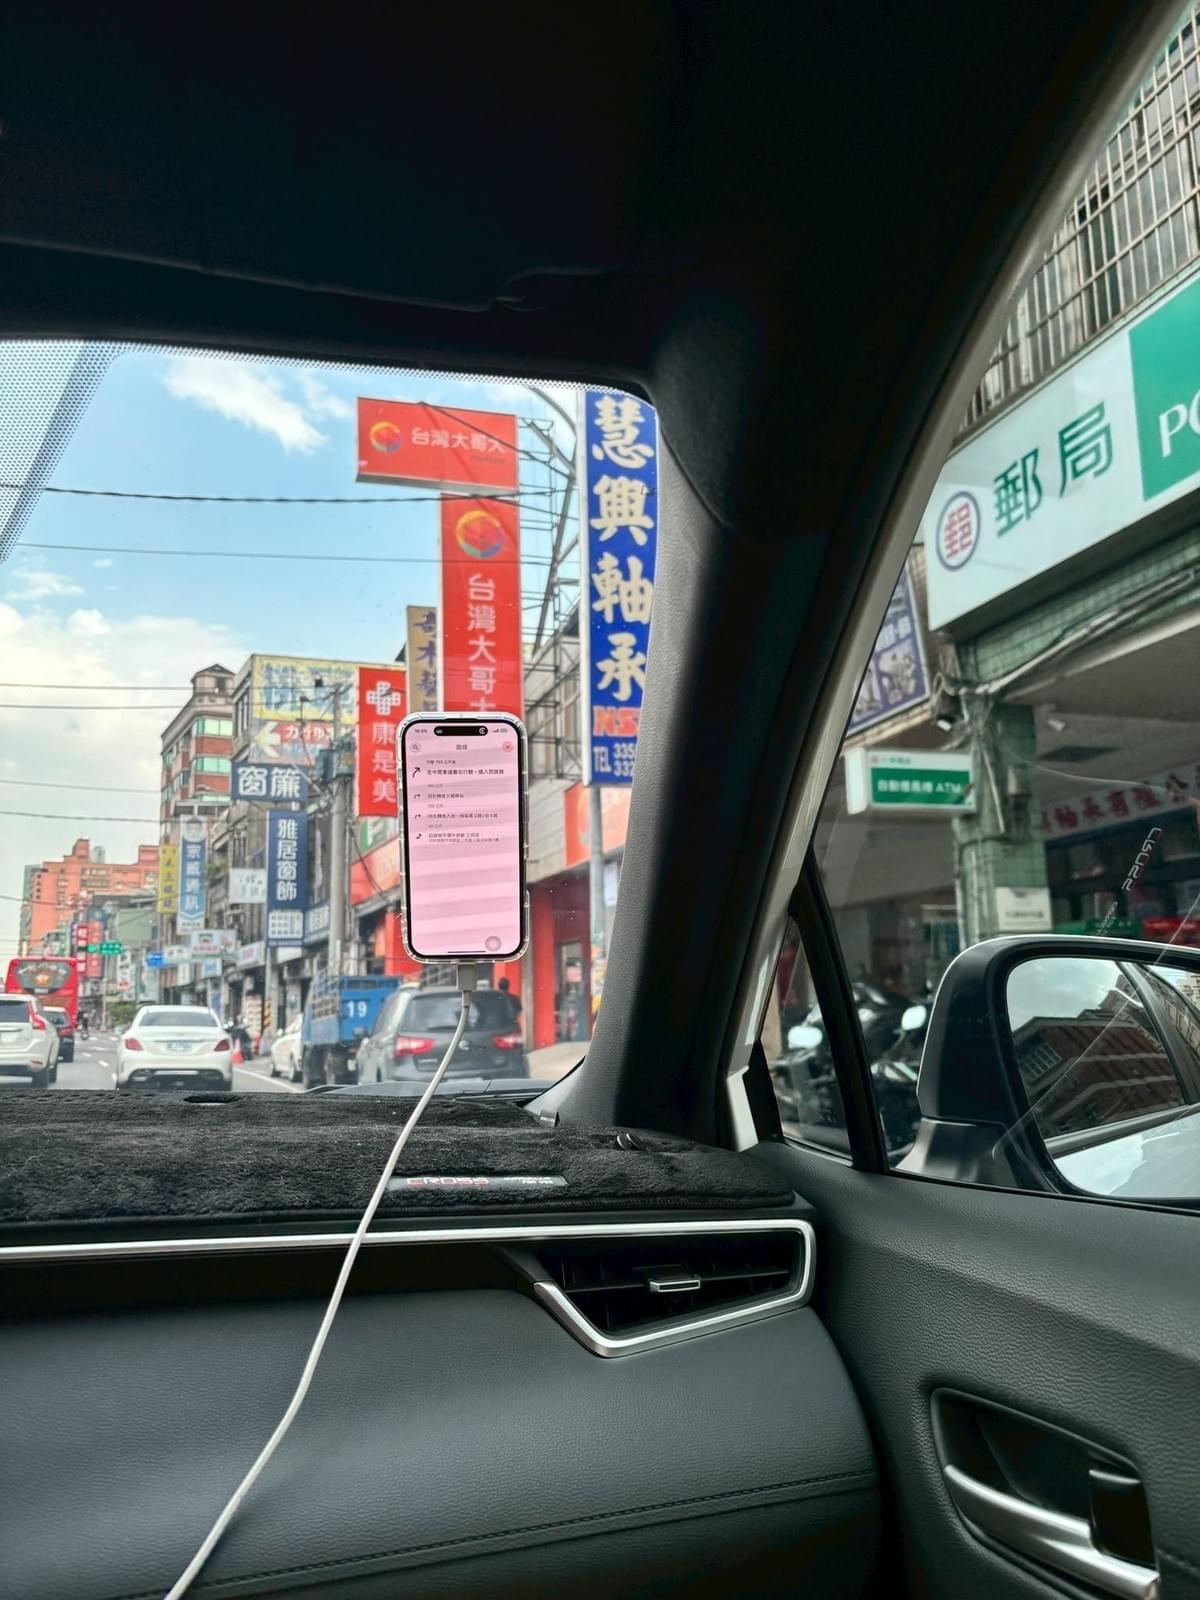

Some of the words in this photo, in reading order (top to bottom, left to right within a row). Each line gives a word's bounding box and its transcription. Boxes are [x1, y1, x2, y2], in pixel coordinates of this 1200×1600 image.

[411, 427, 505, 455] 台灣大哥大
[994, 402, 1113, 539] 郵局
[591, 396, 655, 701] 慧興軸承
[237, 765, 300, 798] 窗簾
[372, 722, 397, 803] 康是美
[276, 818, 298, 901] 雅居窗飾
[347, 1001, 367, 1018] 19
[406, 1176, 490, 1187] CROSS
